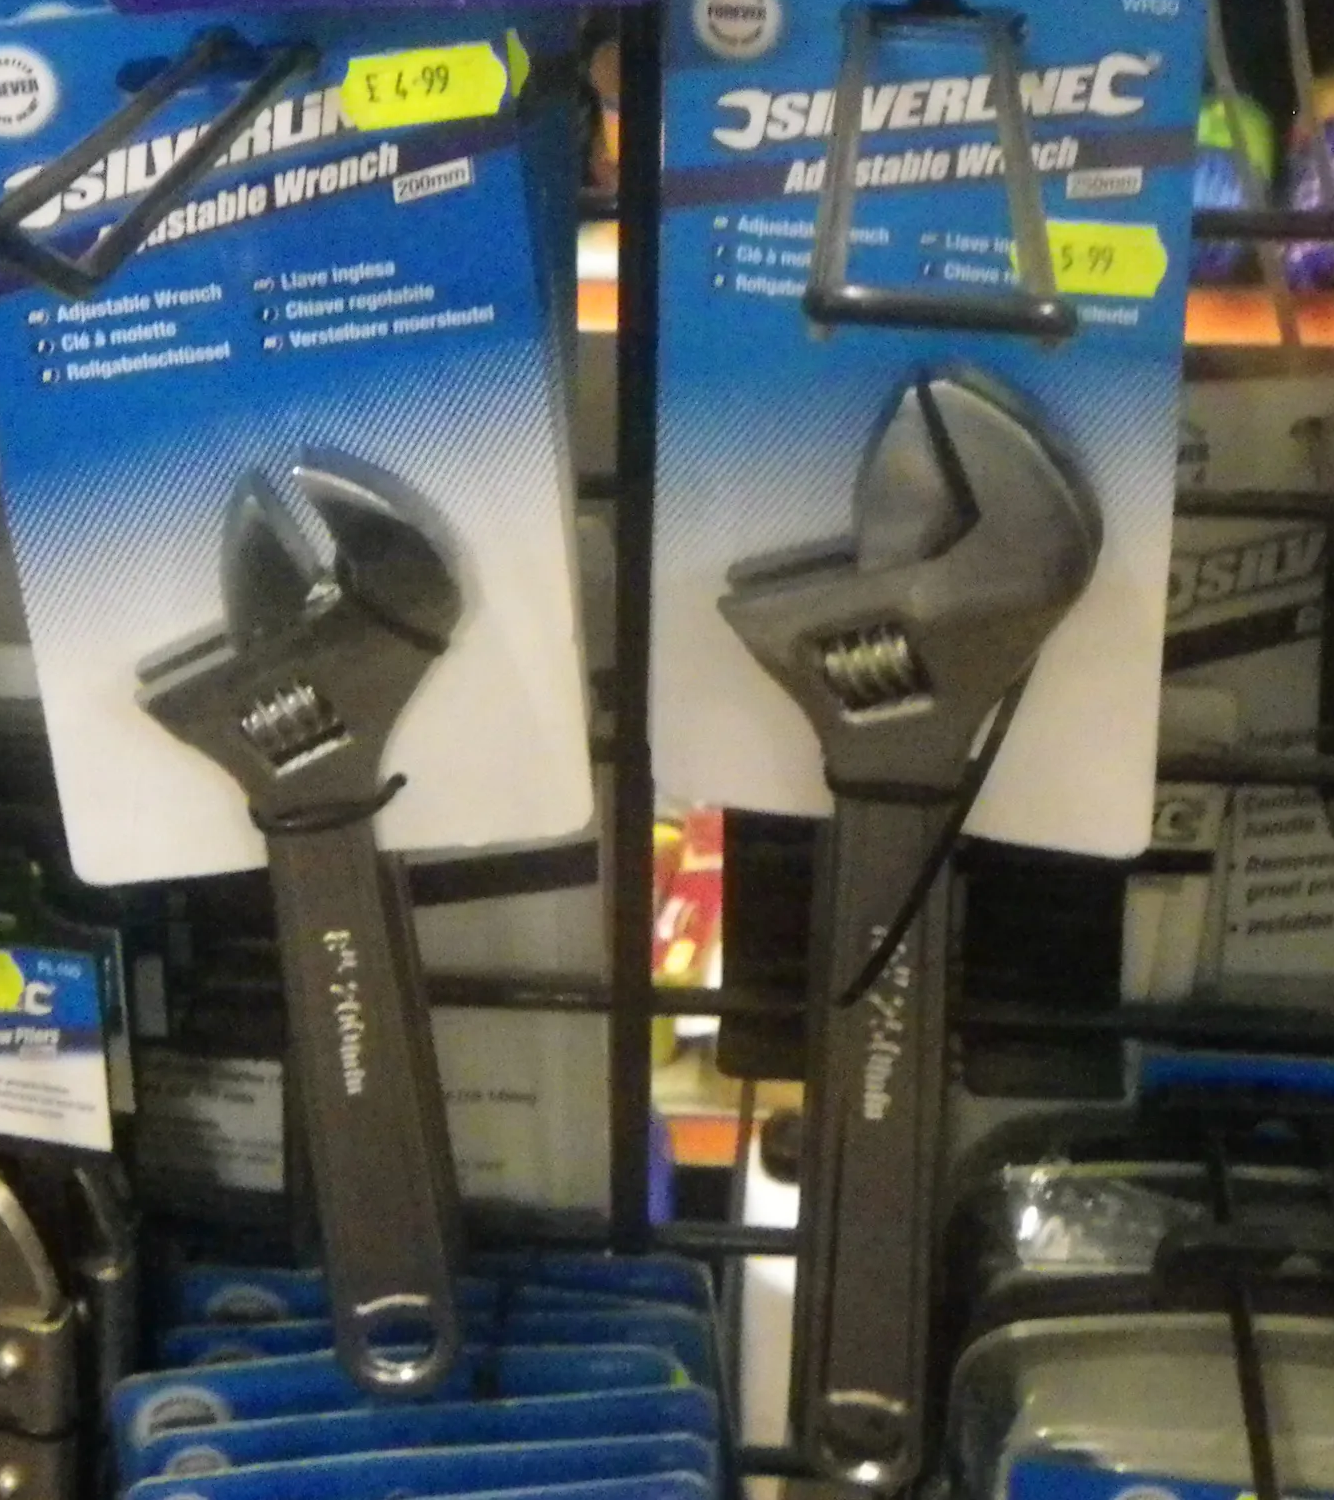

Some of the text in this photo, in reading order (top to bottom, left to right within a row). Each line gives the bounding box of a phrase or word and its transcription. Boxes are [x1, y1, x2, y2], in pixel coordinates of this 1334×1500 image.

[274, 141, 399, 209] Wrench
[395, 167, 468, 199] 200mm
[280, 270, 329, 292] Llave
[56, 282, 223, 325] Adjustable Wrench
[284, 297, 345, 321] Chiave
